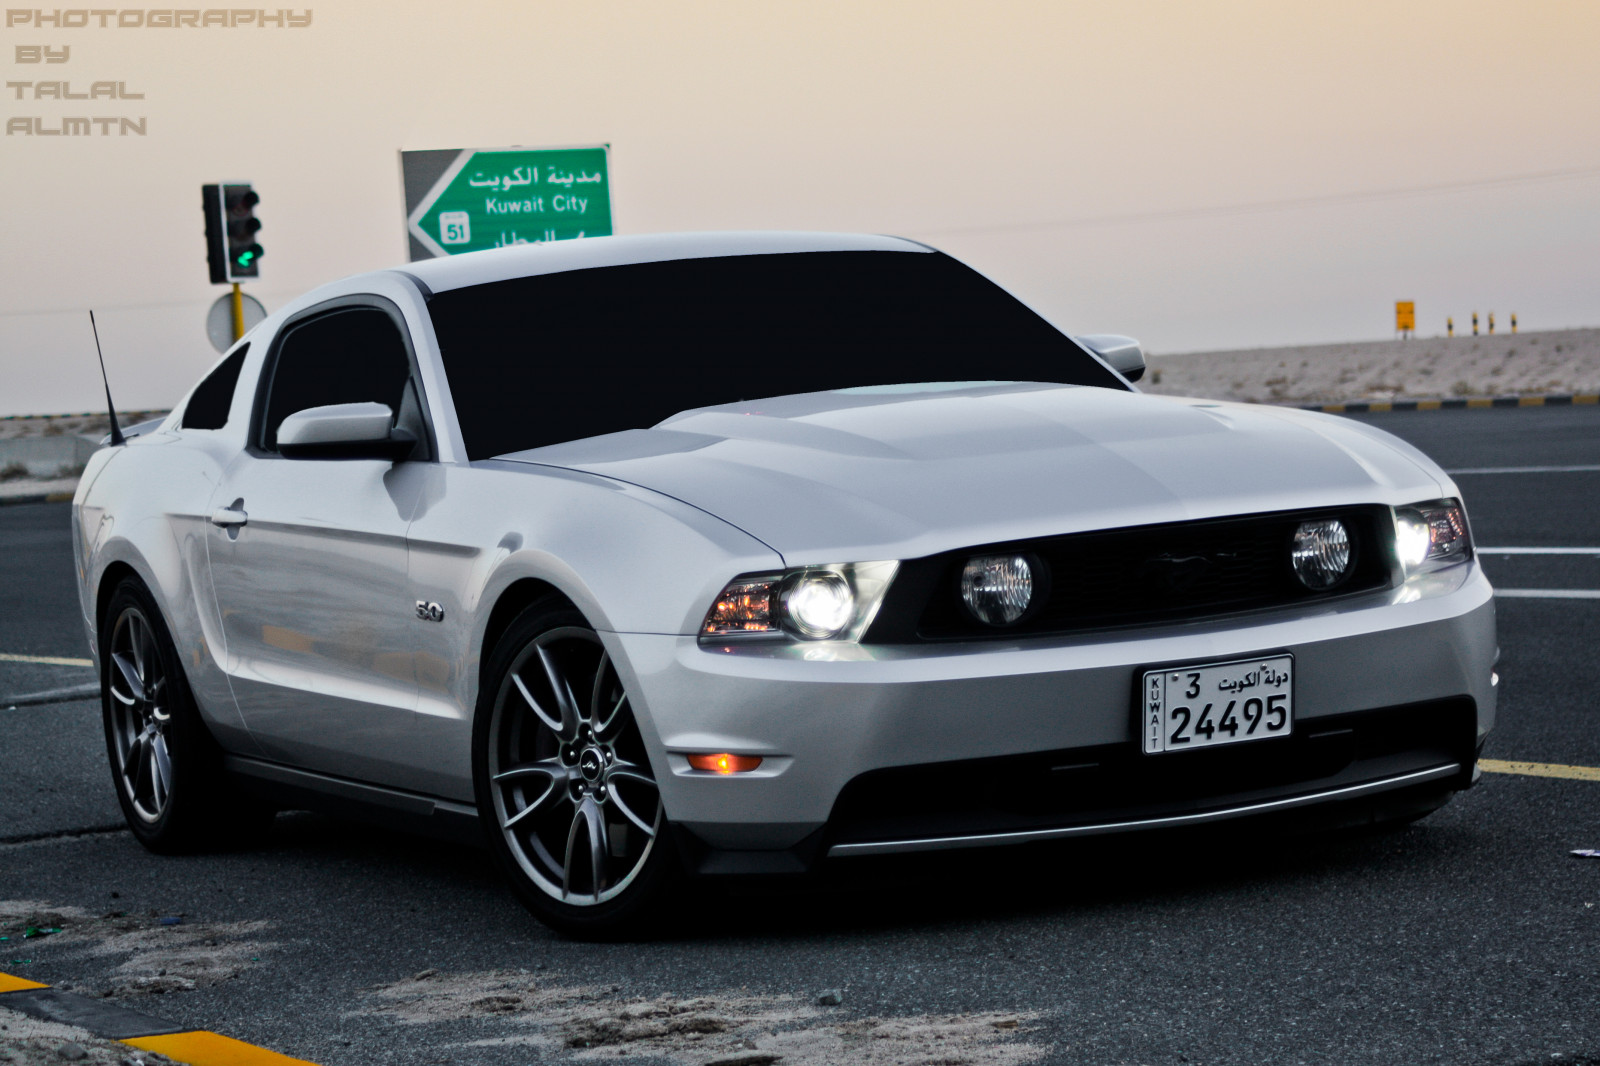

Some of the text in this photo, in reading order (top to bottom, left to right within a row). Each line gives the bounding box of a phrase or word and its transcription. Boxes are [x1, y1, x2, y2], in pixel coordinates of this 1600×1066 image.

[469, 166, 601, 191] مدينة الكويت
[486, 195, 588, 214] Kuwait City
[447, 224, 464, 240] 51
[1186, 673, 1201, 699] 3
[1218, 668, 1289, 694] دولة الكويت
[1150, 677, 1161, 749] KUWAIT
[1170, 694, 1287, 744] 24495
